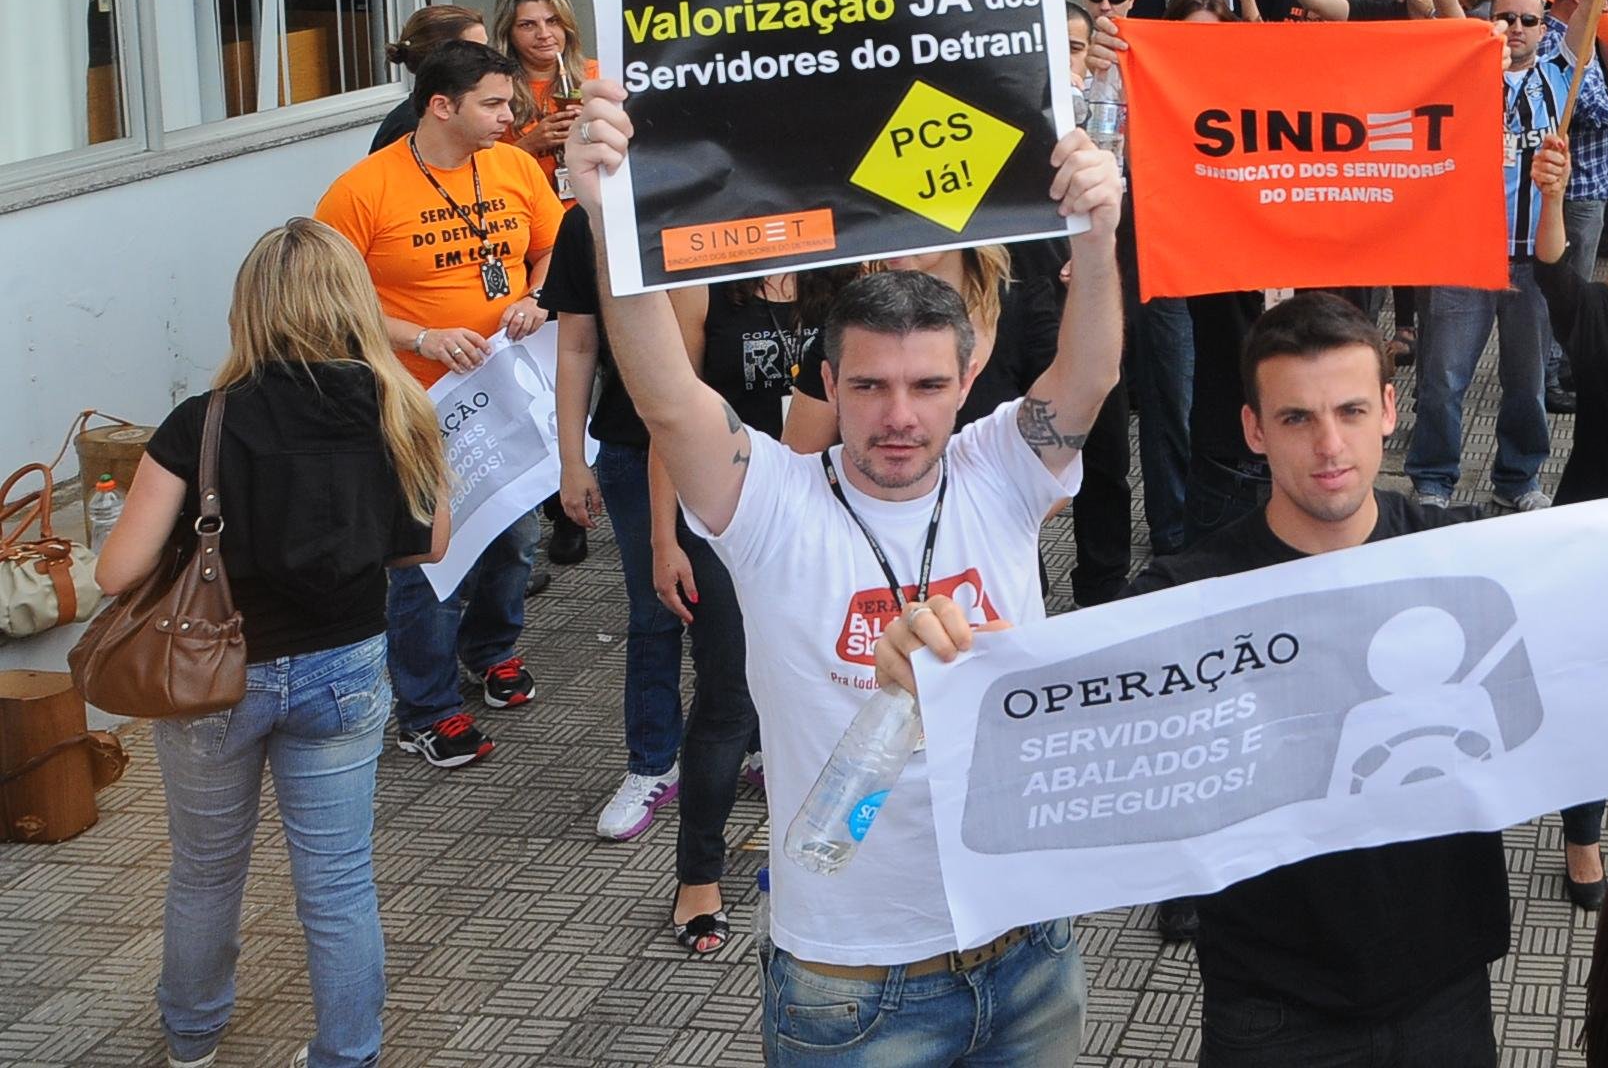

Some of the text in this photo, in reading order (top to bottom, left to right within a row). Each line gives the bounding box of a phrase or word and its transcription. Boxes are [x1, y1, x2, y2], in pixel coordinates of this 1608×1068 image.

[625, 22, 1044, 93] Servidores do Detran!
[890, 112, 974, 158] PCS
[1193, 103, 1454, 158] SINDET
[918, 159, 973, 199] Já!
[1194, 158, 1456, 181] SINDICATO DOS SERVIDORES
[420, 198, 506, 224] SERVDORES
[1260, 186, 1394, 204] DO DETRAN/RS
[412, 217, 518, 248] DO DETN-RS
[690, 219, 805, 252] SINDET
[434, 241, 511, 269] EM LTA
[485, 434, 499, 450] E
[830, 672, 849, 685] Pra
[1003, 632, 1300, 719] OPERAÇÃO
[1019, 691, 1257, 762] SERVIDORES
[1022, 724, 1263, 797] ABALADOS E
[1027, 762, 1257, 829] INSEGUROS!
